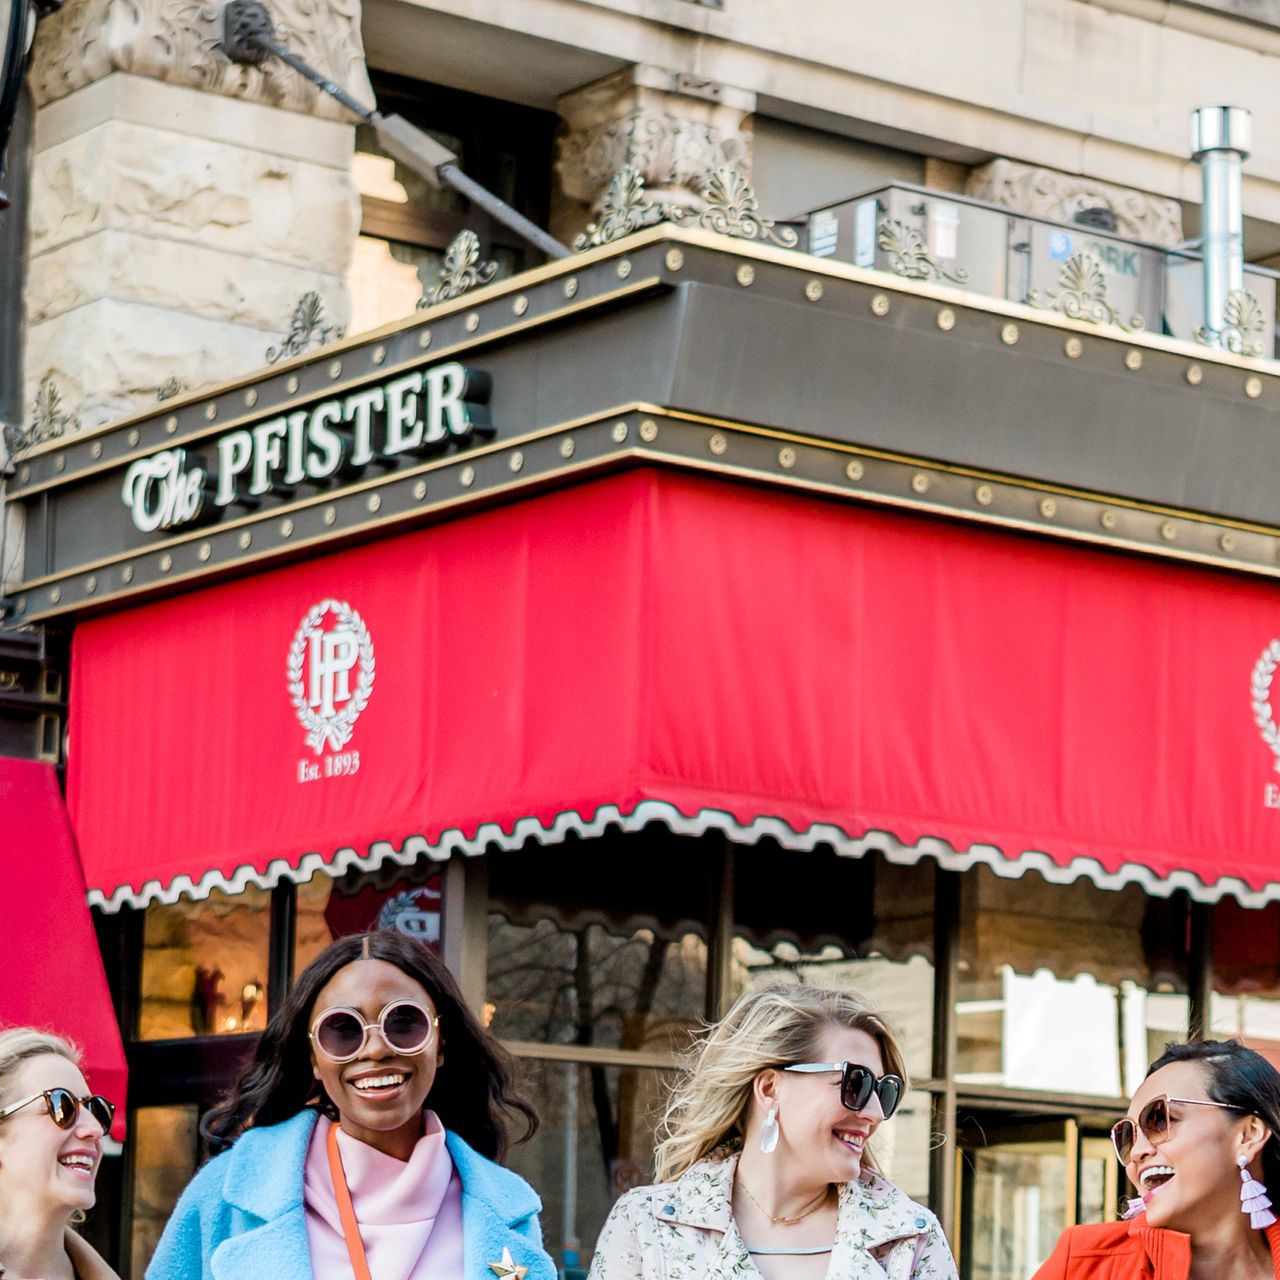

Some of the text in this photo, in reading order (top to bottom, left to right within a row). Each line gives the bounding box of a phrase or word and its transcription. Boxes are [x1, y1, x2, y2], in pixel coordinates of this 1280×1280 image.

[122, 361, 471, 532] The PFISTER
[296, 751, 361, 785] Est. 1893
